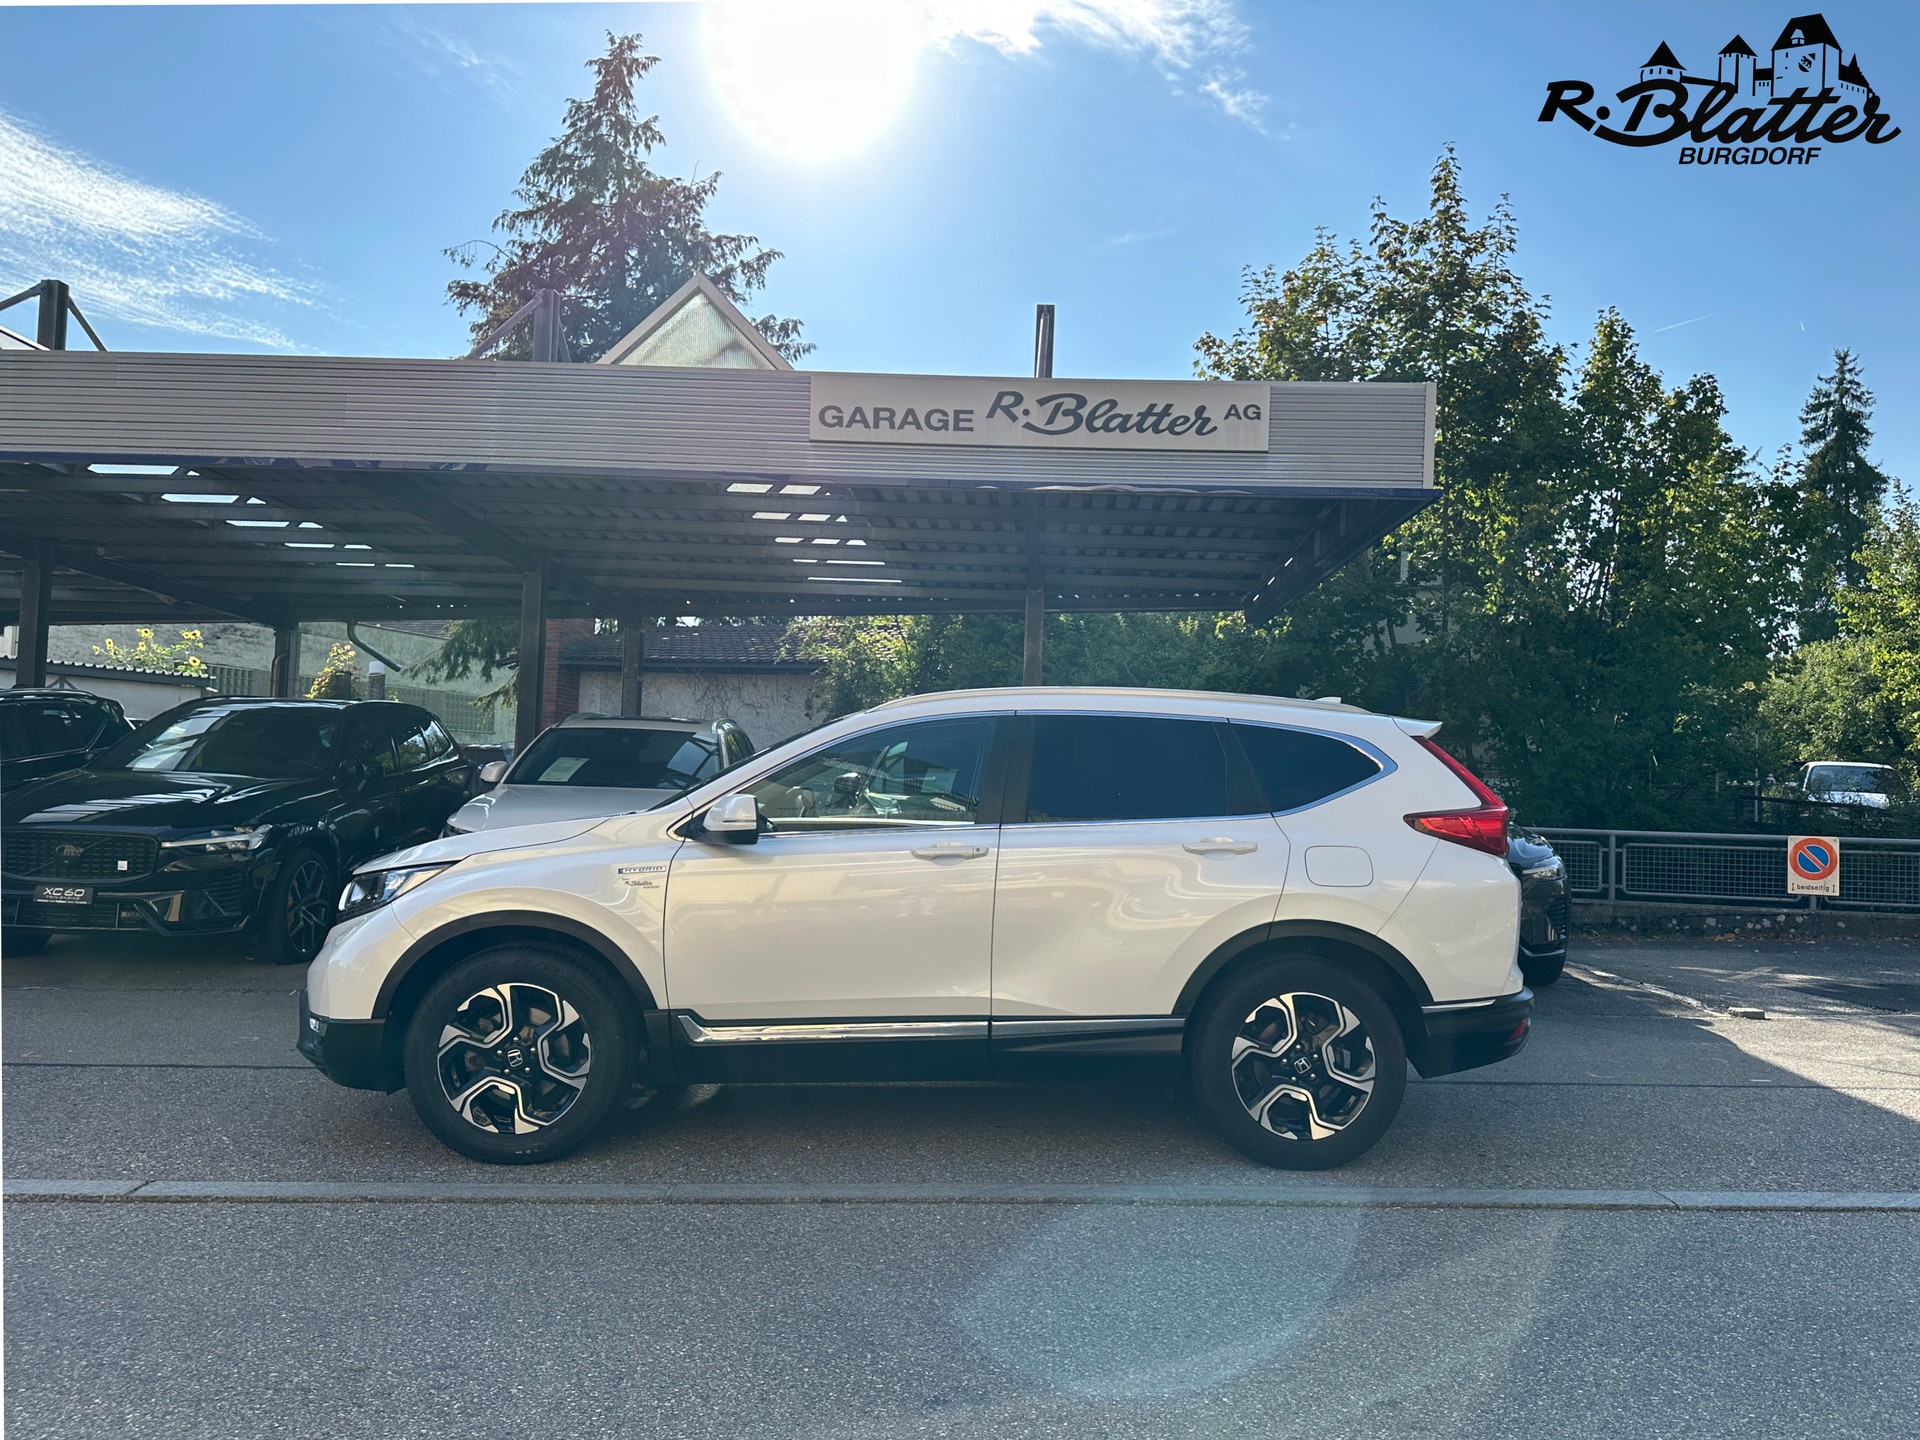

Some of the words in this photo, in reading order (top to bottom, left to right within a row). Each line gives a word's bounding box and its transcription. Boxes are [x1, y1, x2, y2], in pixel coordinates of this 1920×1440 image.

[818, 405, 974, 432] GARAGE
[1223, 403, 1262, 421] AG
[1796, 884, 1830, 892] beidseitig
